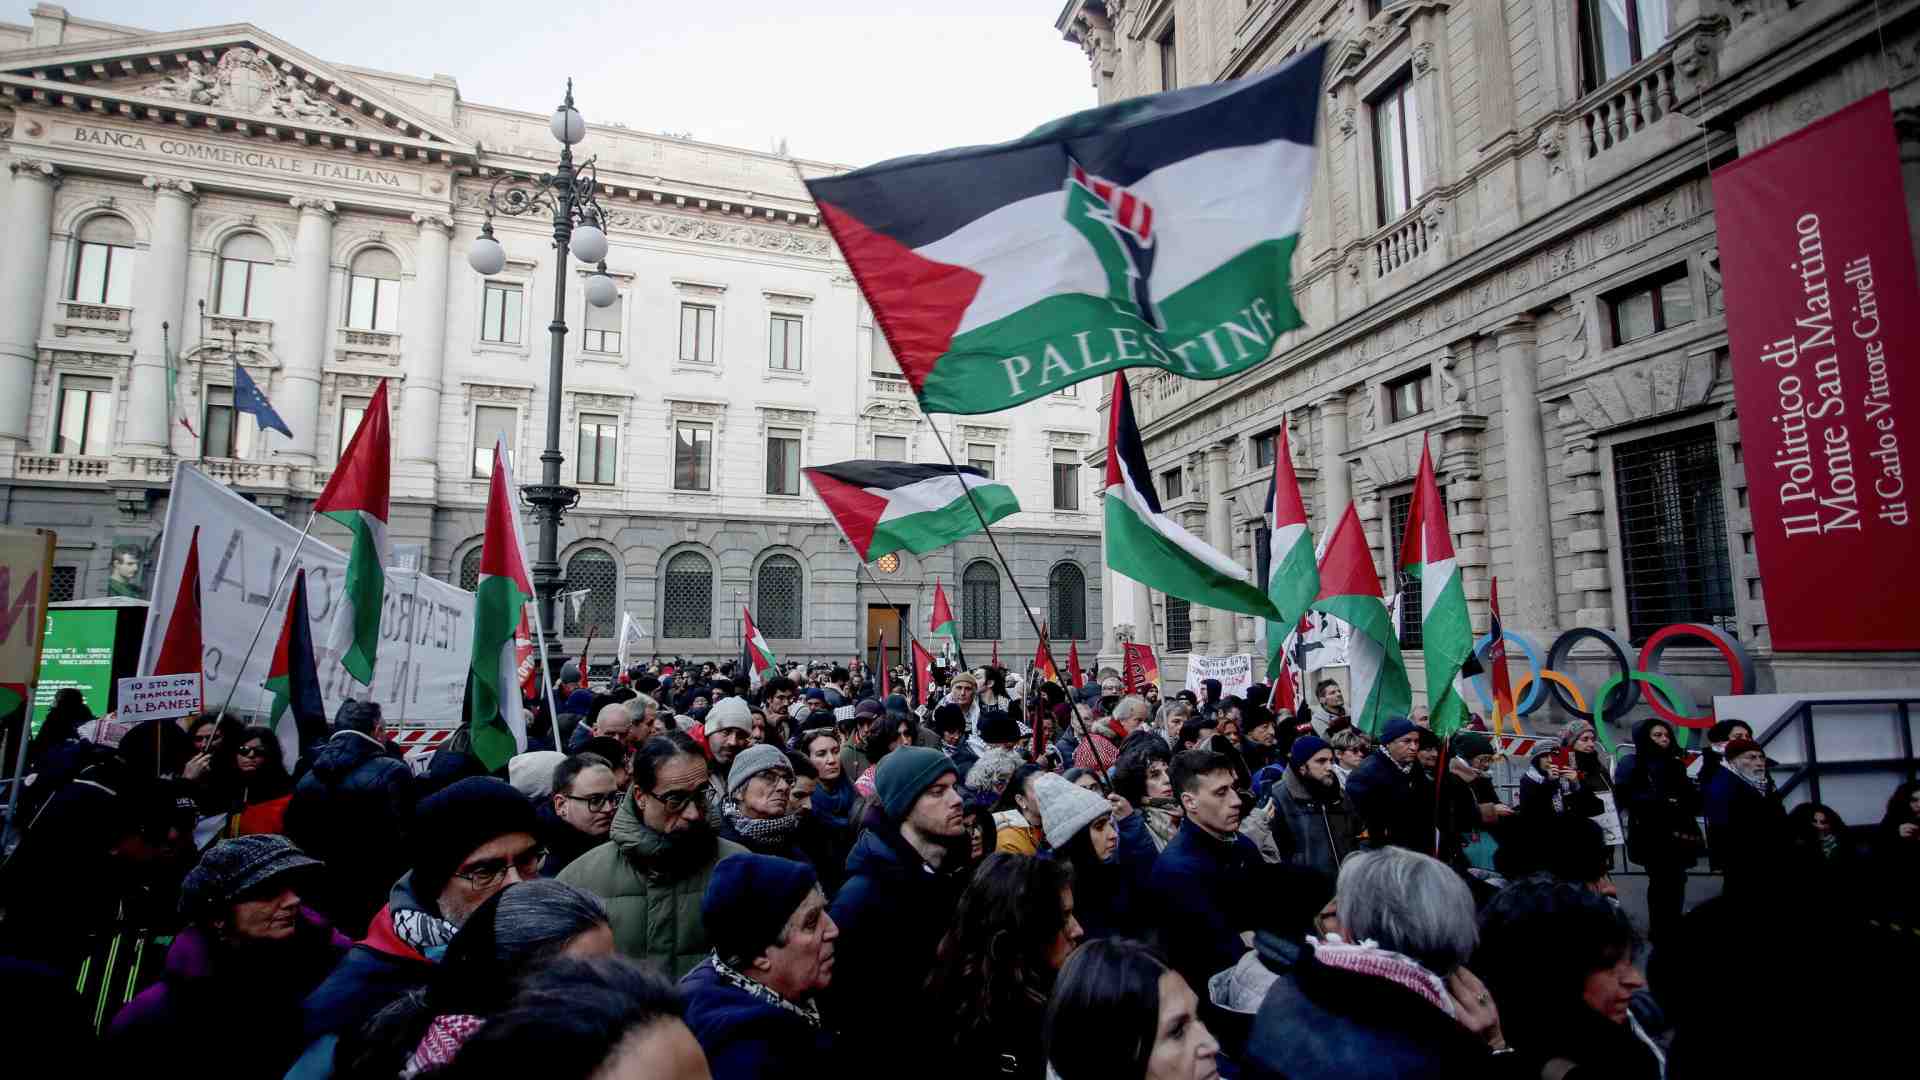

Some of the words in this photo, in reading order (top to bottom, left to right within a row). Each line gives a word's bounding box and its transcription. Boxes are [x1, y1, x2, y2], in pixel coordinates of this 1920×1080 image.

[74, 127, 146, 150] BANCA
[160, 140, 302, 172] COMMERCIALE
[311, 162, 400, 186] ITALIANA
[1790, 213, 1836, 353] Martino
[1844, 254, 1880, 338] Crivelli
[1001, 297, 1273, 397] PALESTINE
[1760, 335, 1798, 367] di
[1806, 354, 1845, 419] San
[1864, 340, 1892, 421] Vittore
[1772, 375, 1817, 504] Polittico
[1876, 417, 1894, 431] e
[1819, 424, 1862, 533] Monte
[1870, 433, 1904, 498] Carlo
[1781, 511, 1821, 538] Il
[1879, 501, 1908, 526] di
[123, 698, 200, 714] ALBANESE
[134, 689, 191, 699] FRANCESCA
